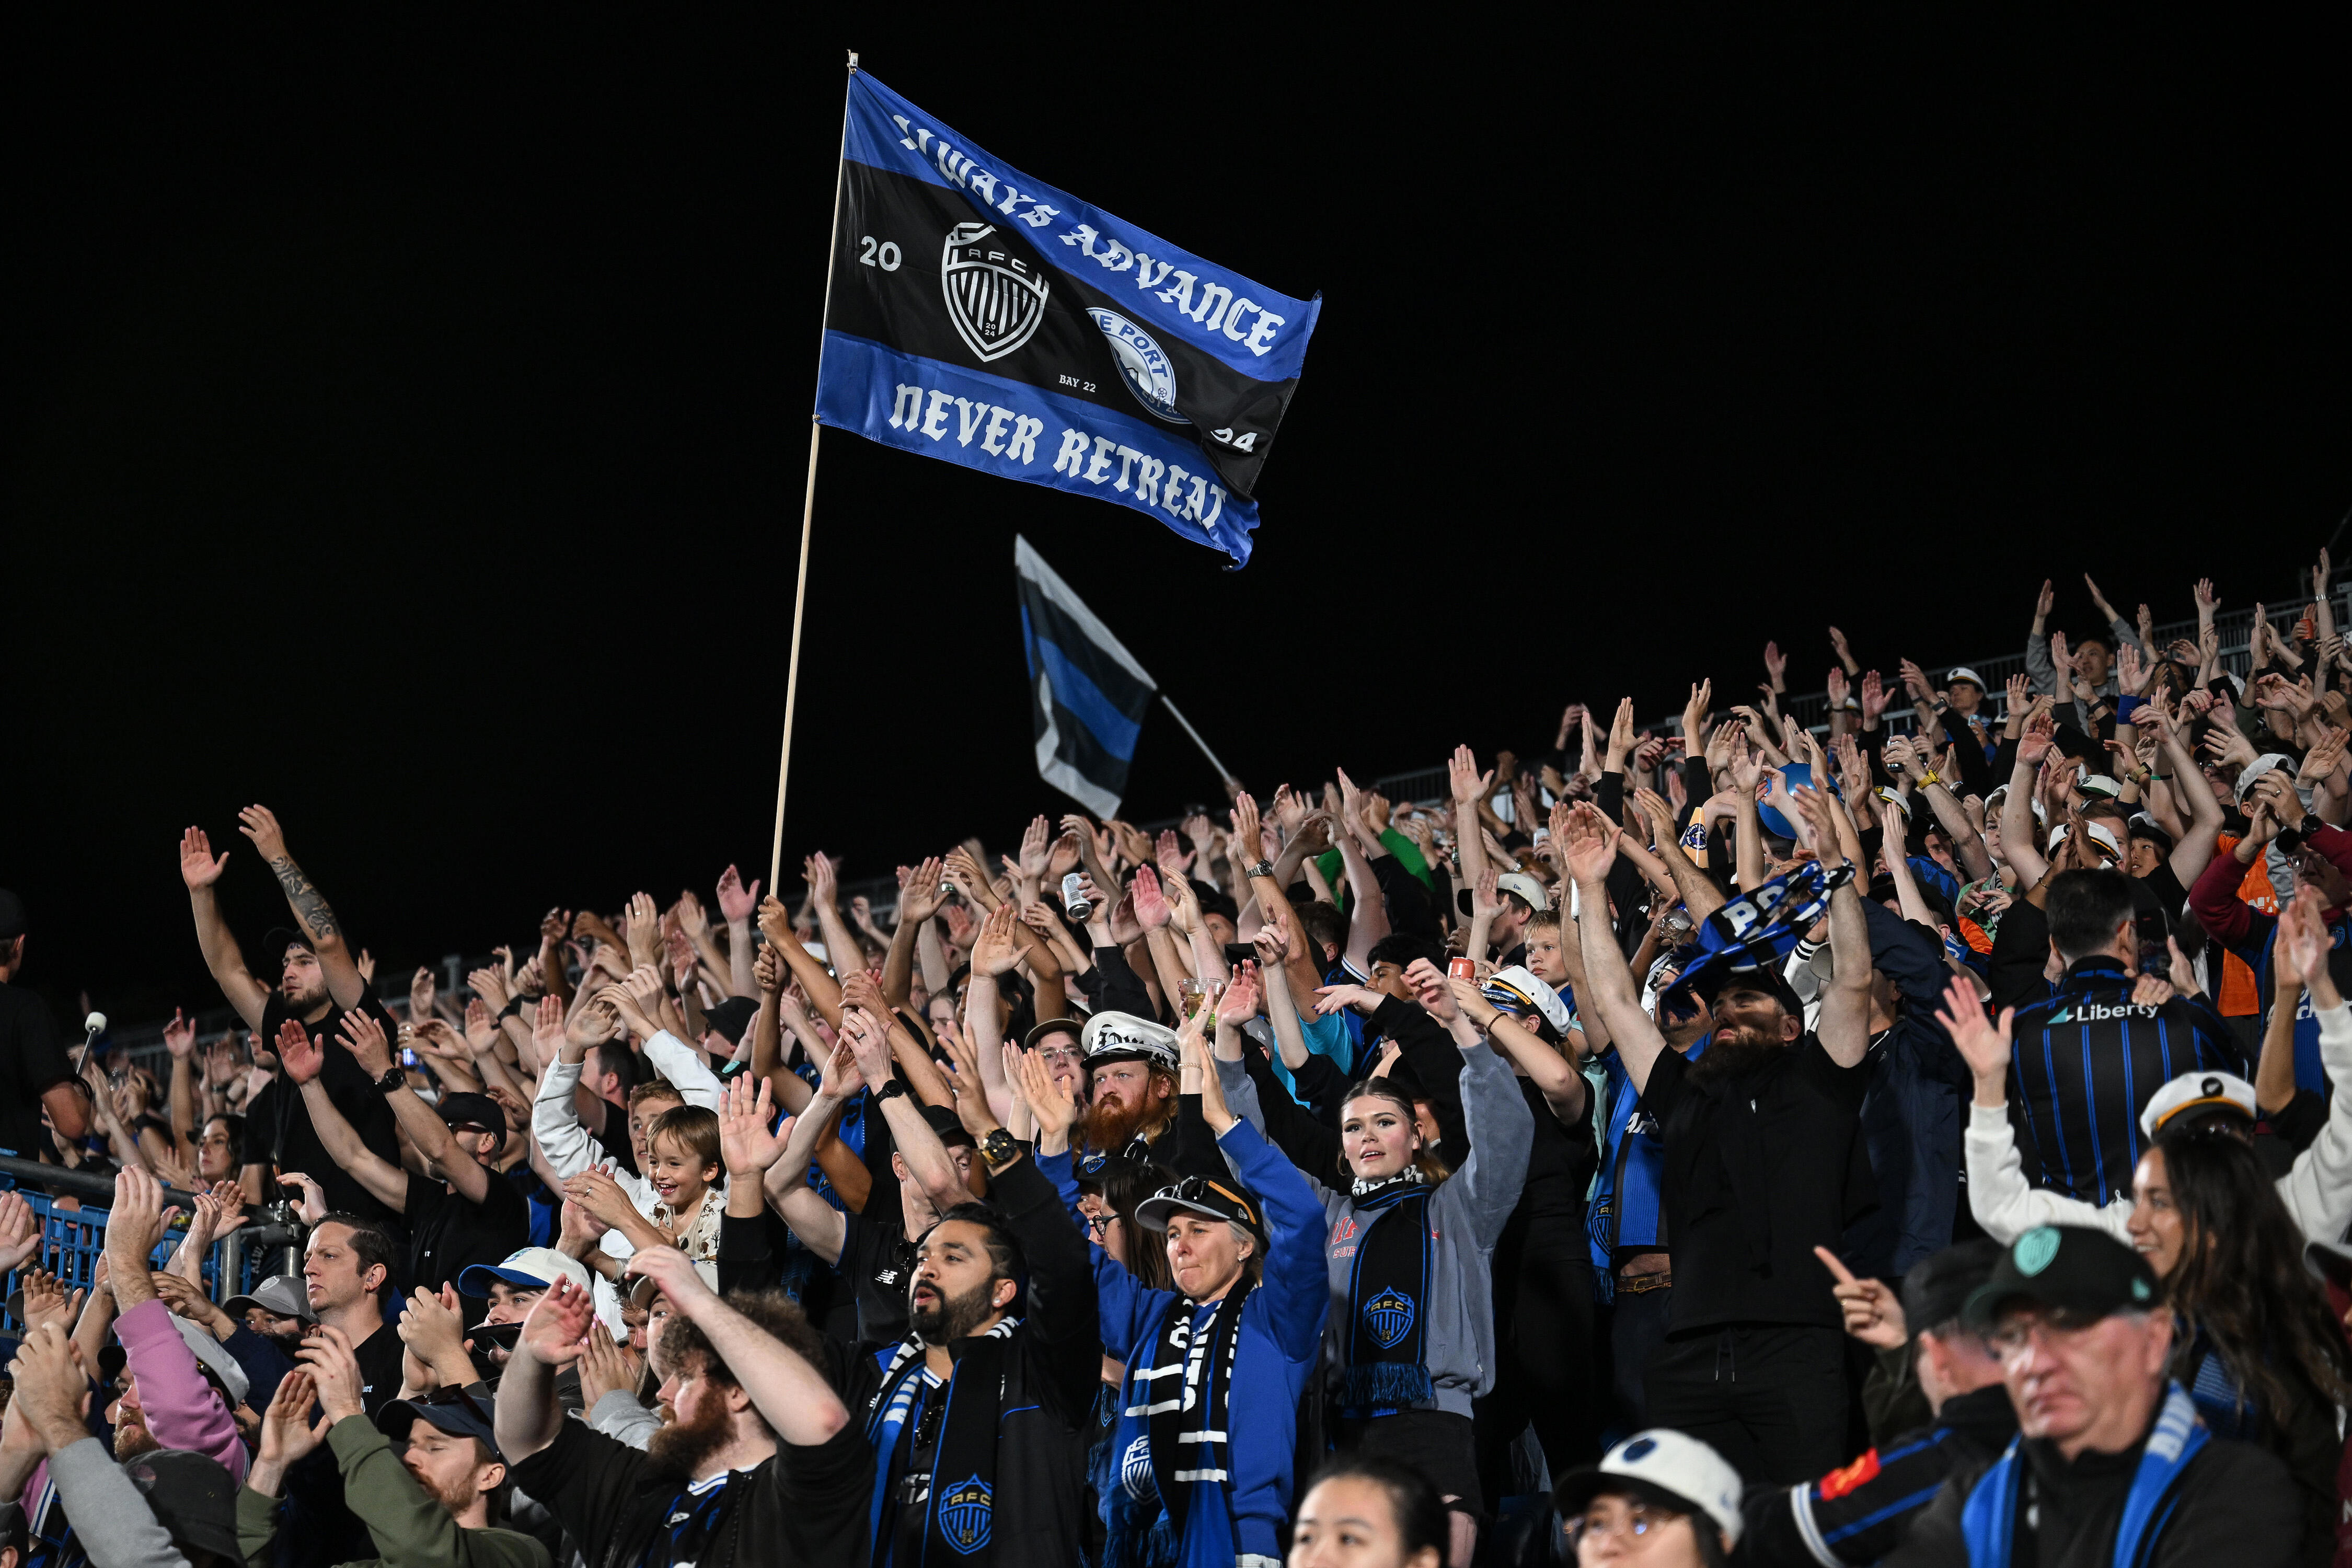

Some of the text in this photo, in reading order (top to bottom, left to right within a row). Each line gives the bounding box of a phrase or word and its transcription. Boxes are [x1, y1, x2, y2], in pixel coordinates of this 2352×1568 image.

[859, 235, 902, 271] 20
[969, 248, 1027, 273] AFC
[1058, 224, 1285, 356] ADVANCE
[1119, 324, 1168, 378] PORT
[1059, 374, 1096, 393] BAY 22
[889, 383, 1227, 531] NEVER RETREAT
[2077, 1004, 2158, 1022] Liberty
[1333, 1246, 1357, 1259] SUR
[1371, 1301, 1404, 1312] AFC
[951, 1492, 991, 1506] AFC
